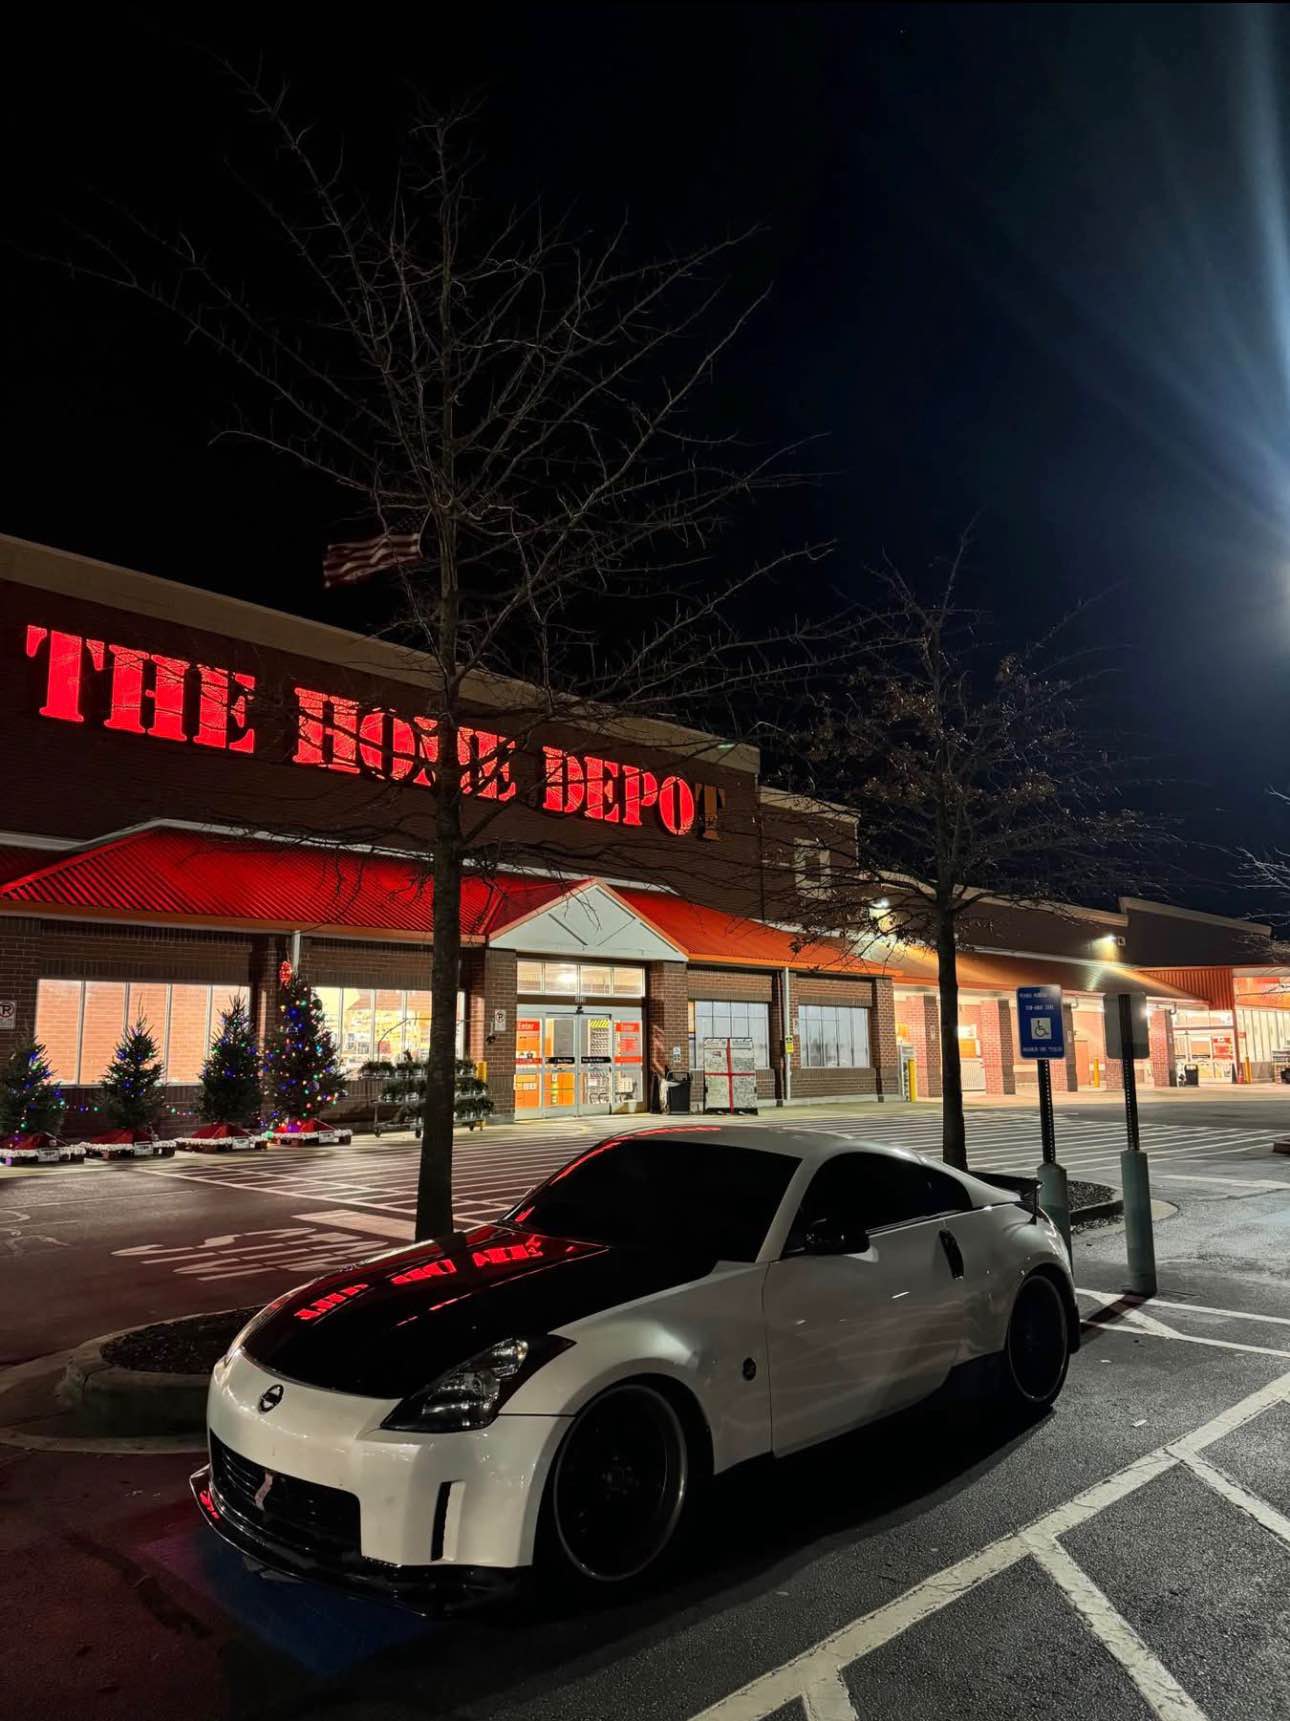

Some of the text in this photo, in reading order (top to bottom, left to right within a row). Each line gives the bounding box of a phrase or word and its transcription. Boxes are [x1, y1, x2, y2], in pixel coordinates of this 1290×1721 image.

[26, 624, 727, 842] THE HOME DEPOT
